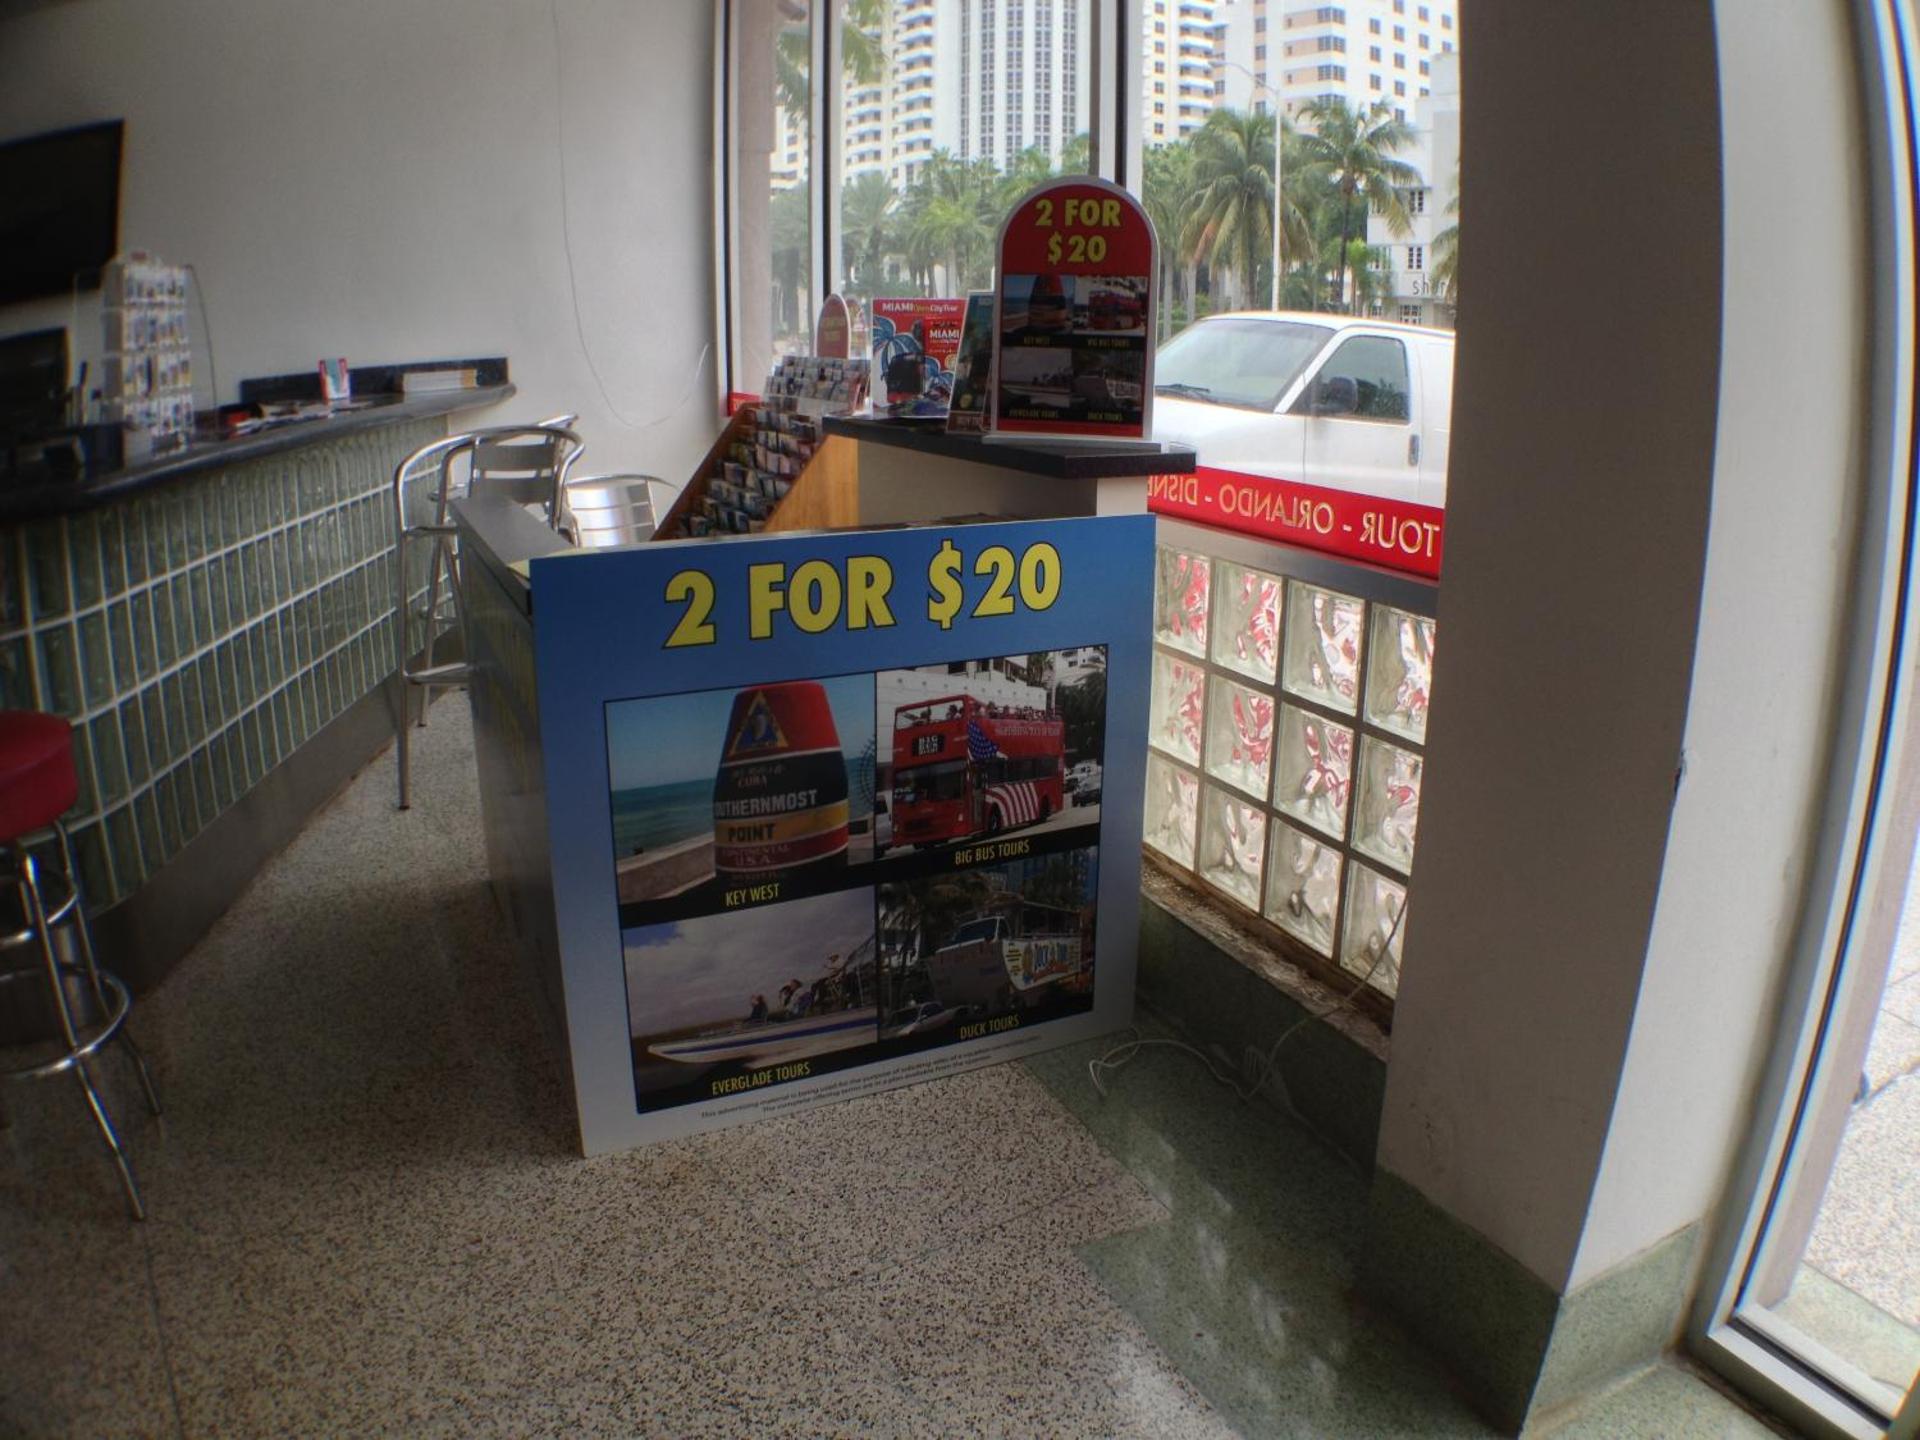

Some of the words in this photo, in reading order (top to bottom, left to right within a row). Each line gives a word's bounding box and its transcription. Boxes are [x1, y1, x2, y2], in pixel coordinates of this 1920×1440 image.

[1035, 199, 1053, 226] 2
[1065, 199, 1121, 227] FOR
[1048, 231, 1107, 266] $20
[882, 303, 913, 313] MIAMI
[929, 329, 960, 339] MIAMI
[662, 570, 716, 648] 2
[748, 555, 896, 639] FOR
[926, 538, 1063, 630] $20
[728, 822, 776, 842] POINT
[955, 849, 973, 865] BIG
[976, 844, 996, 862] BUS
[998, 839, 1030, 857] TOURS
[725, 888, 747, 907] KEY
[750, 882, 780, 902] WEST
[960, 1023, 986, 1040] DUCK
[989, 1014, 1020, 1033] TOURS
[712, 1069, 773, 1096] EVERGLADE
[776, 1061, 811, 1081] TOURS
